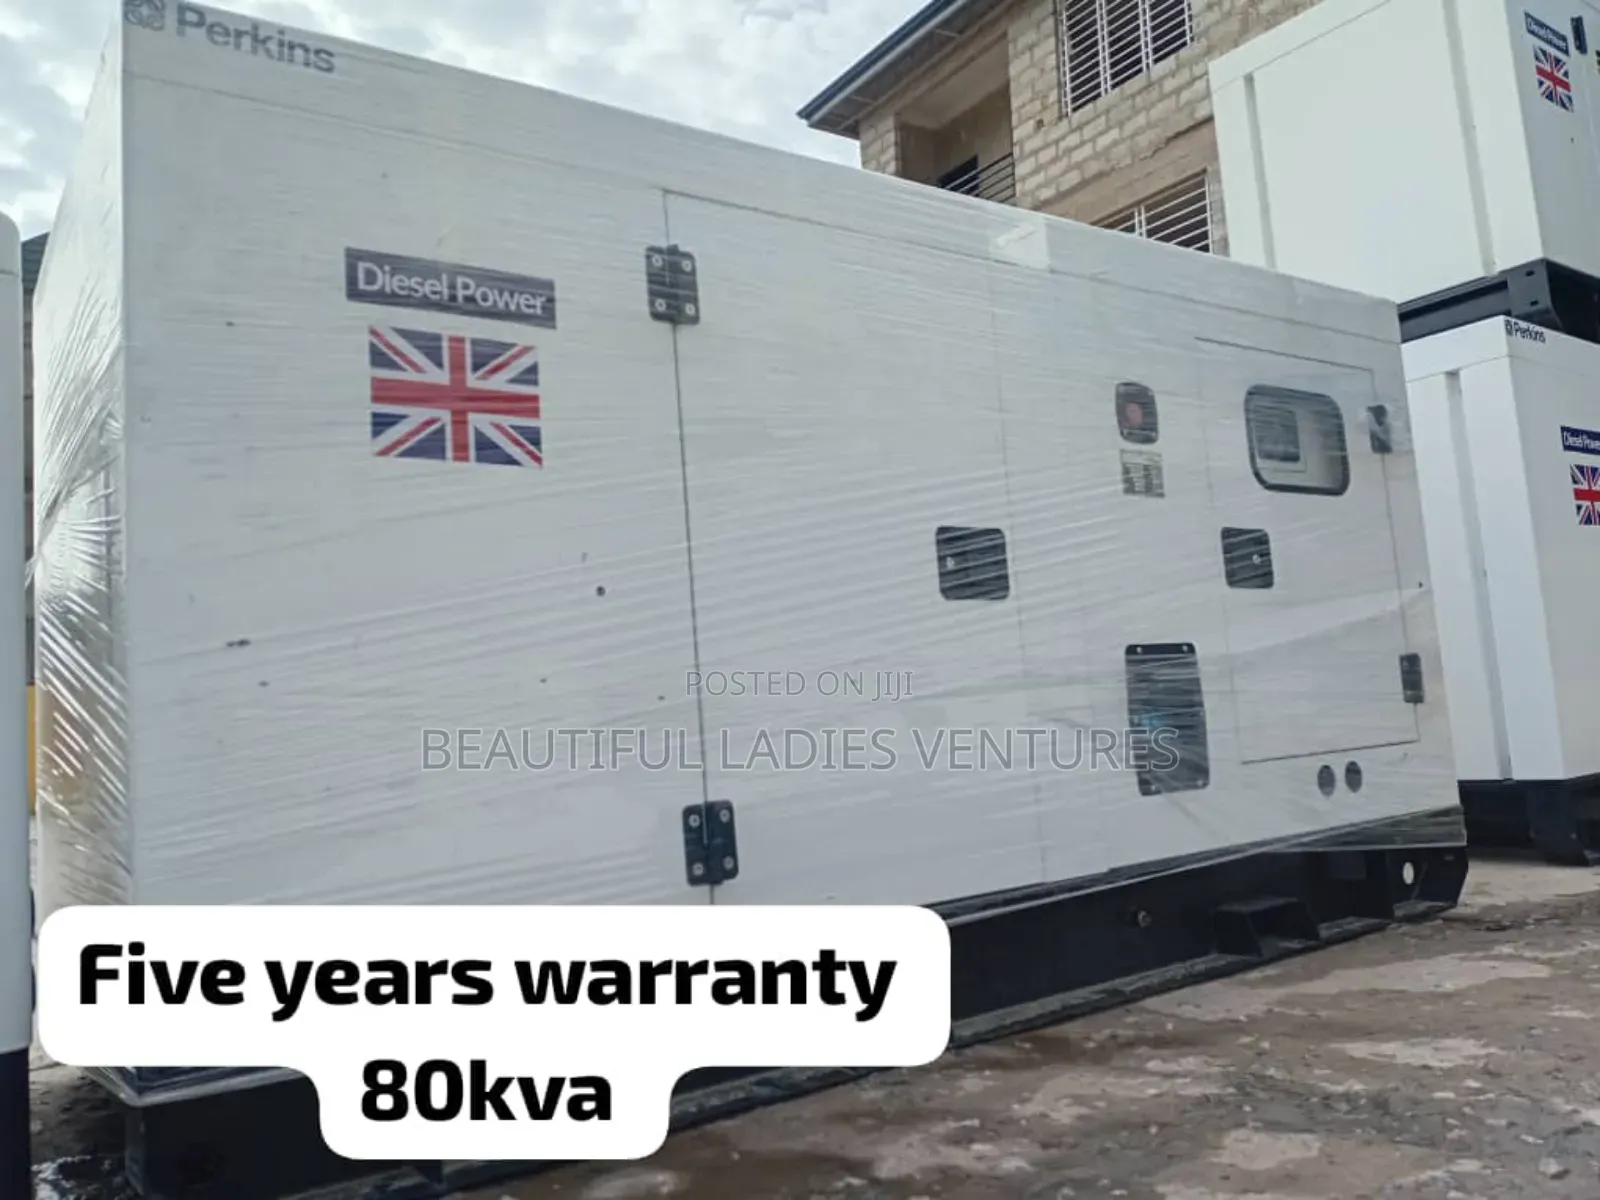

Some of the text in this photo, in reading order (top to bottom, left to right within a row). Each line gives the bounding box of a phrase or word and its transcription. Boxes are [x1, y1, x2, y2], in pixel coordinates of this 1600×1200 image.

[176, 3, 336, 73] Perkins
[357, 261, 547, 314] Diesel Power
